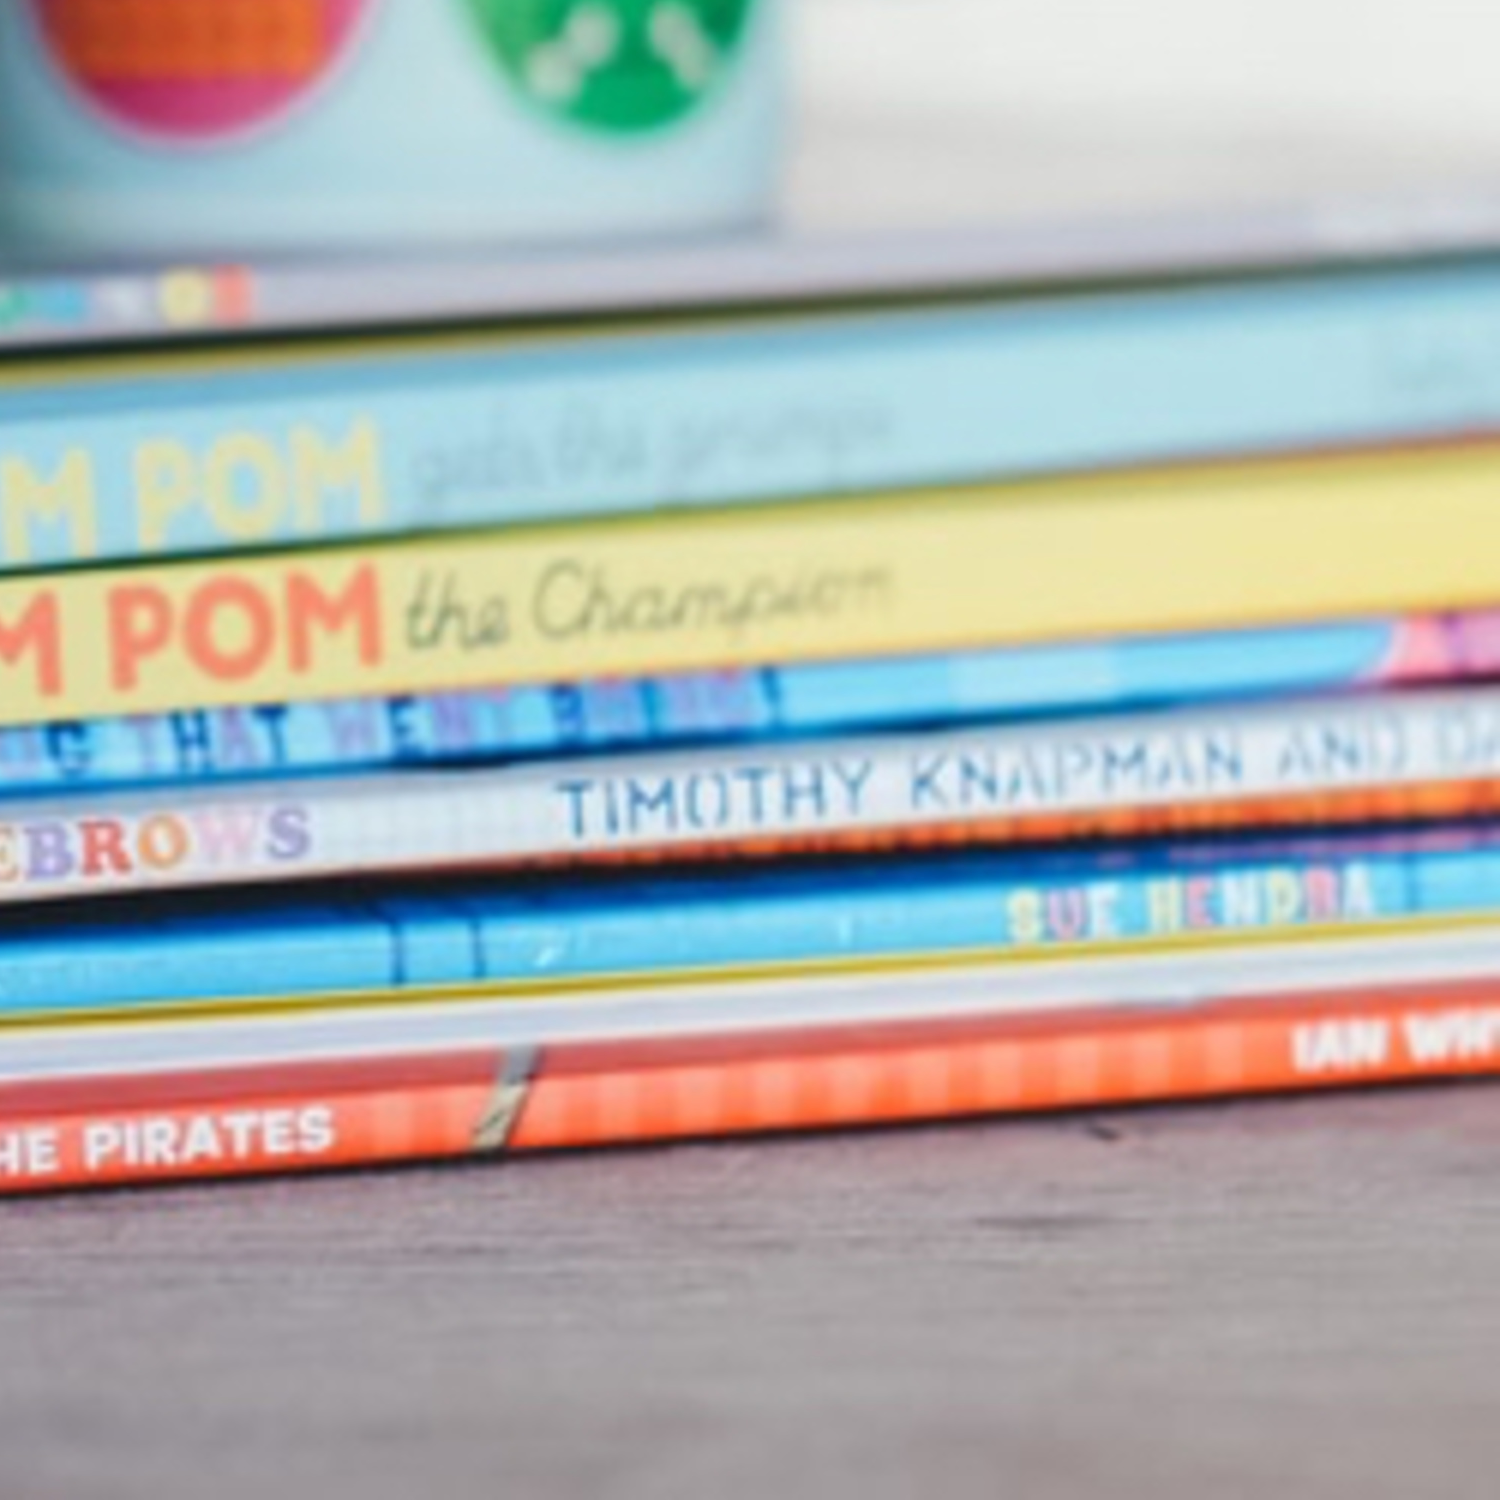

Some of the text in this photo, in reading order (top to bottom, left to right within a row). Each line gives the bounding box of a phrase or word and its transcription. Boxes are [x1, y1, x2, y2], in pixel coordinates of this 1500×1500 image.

[133, 414, 386, 554] POM
[107, 559, 382, 693] POM
[404, 566, 510, 651] the
[530, 559, 892, 644] Champion
[554, 755, 876, 839] TIMOTHY
[908, 729, 1244, 809] KNAPMAN
[1276, 708, 1407, 781] AND
[1005, 876, 1122, 945] SUE
[1292, 1017, 1389, 1073] IAN
[82, 1104, 337, 1171] PIRATES
